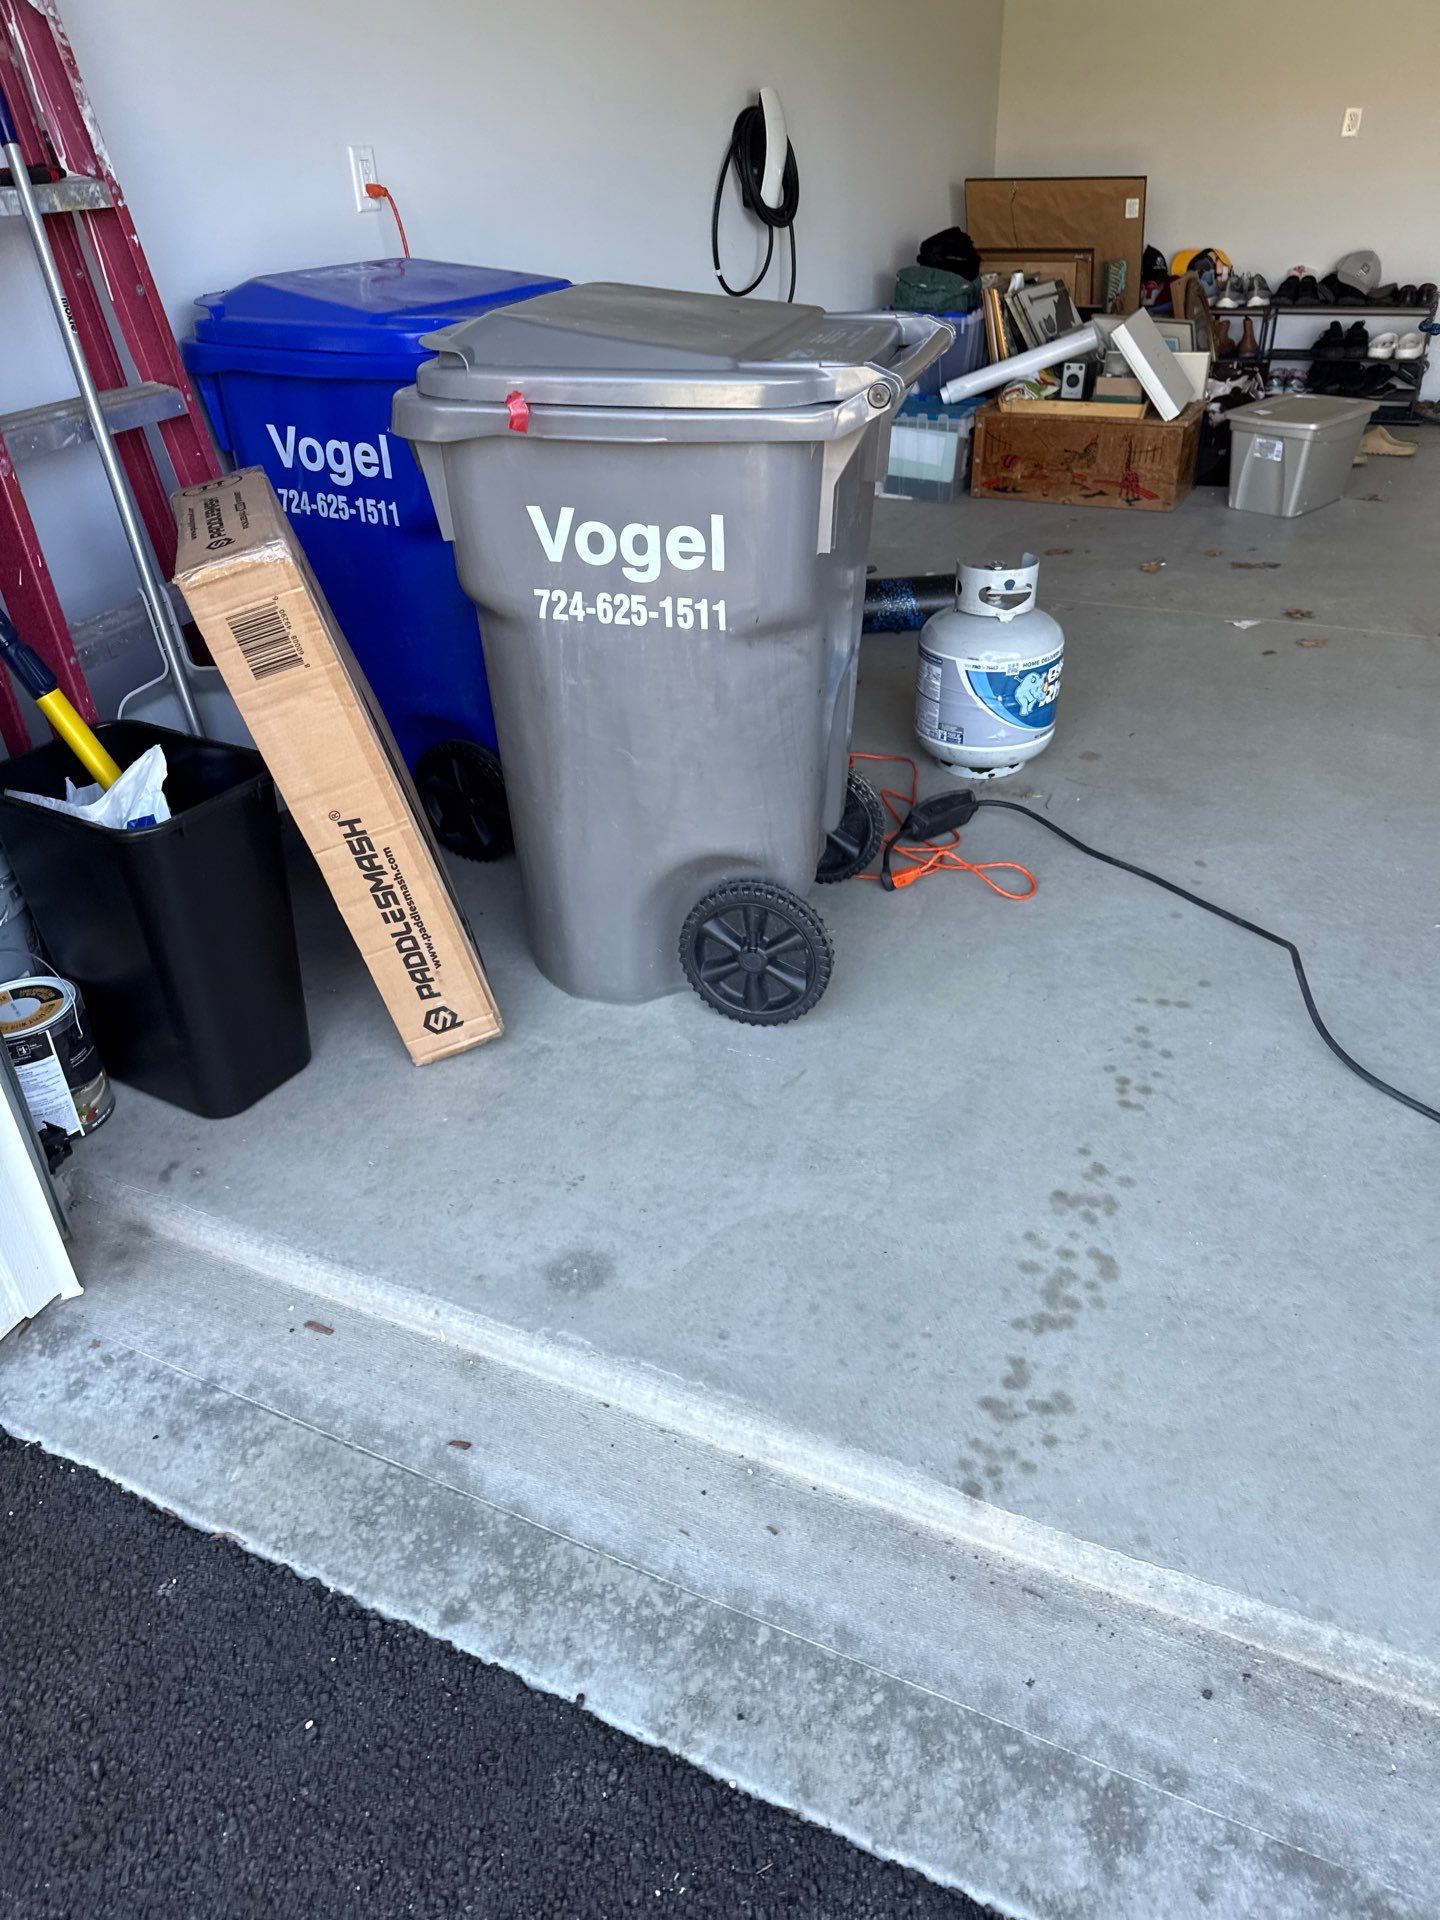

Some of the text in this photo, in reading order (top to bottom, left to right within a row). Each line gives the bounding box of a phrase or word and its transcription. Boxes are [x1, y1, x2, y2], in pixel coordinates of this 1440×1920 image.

[265, 423, 393, 487] Vogel
[276, 488, 401, 527] 724-625-1511
[525, 505, 726, 584] Vogel
[279, 609, 292, 630] 49290
[533, 588, 727, 632] 724-625-1511
[1022, 659, 1040, 668] HOME
[382, 845, 442, 970] www.paddlesmash.com
